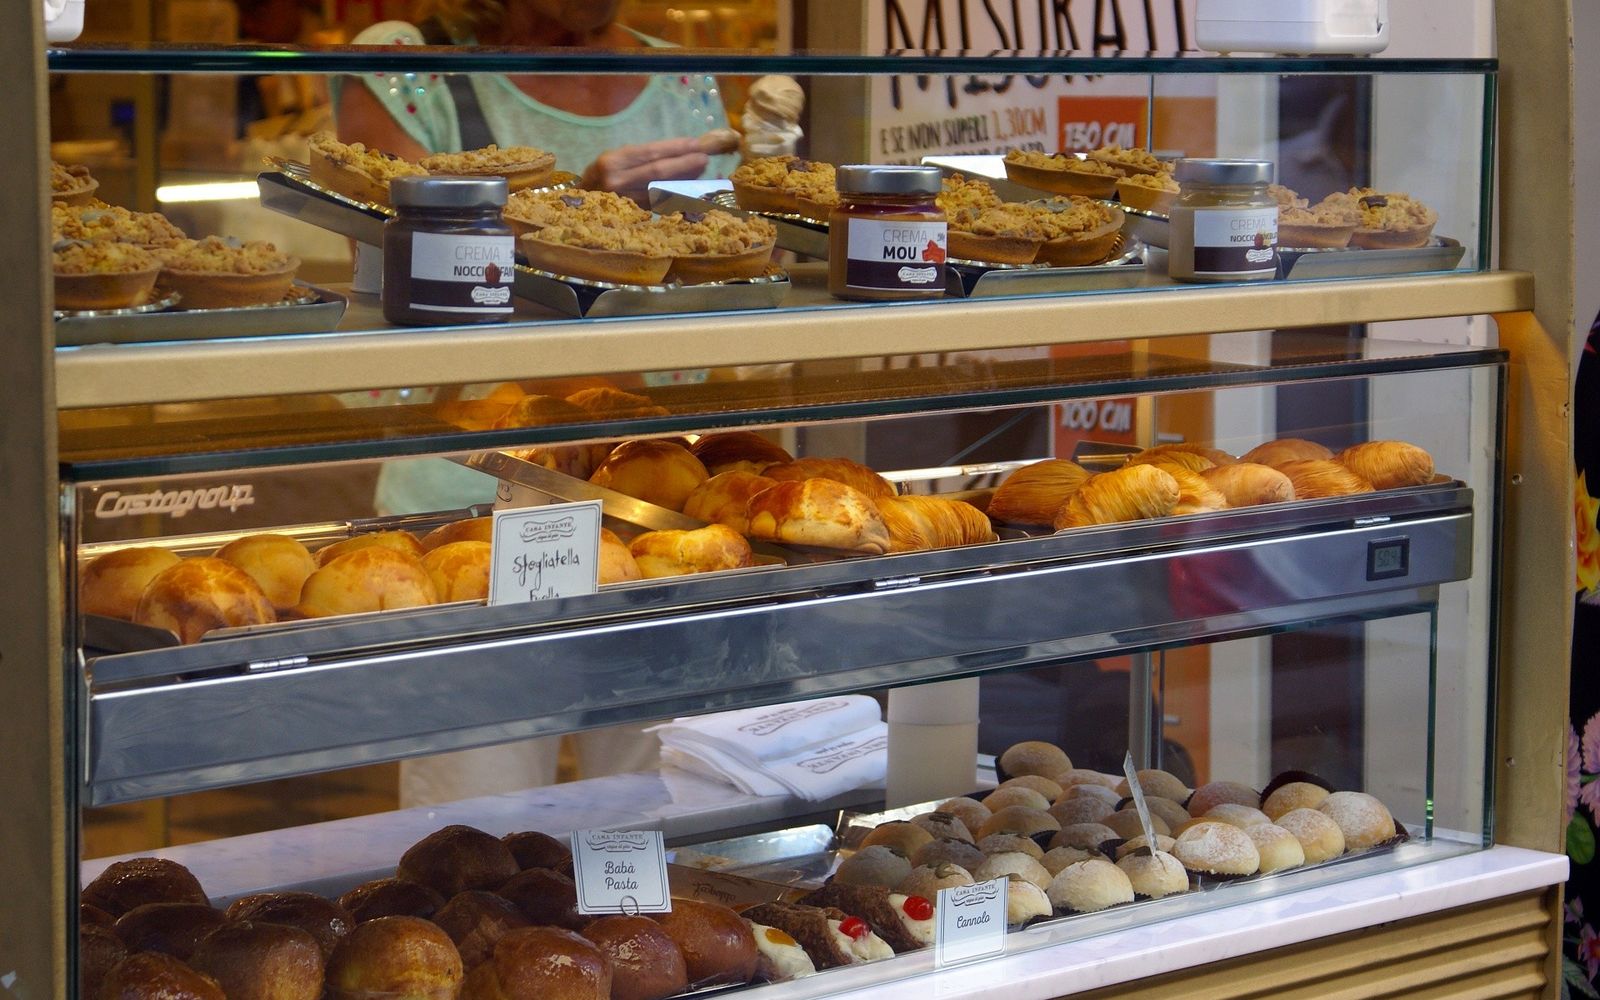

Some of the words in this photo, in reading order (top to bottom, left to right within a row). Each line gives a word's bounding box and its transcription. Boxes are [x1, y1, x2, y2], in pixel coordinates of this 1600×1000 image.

[879, 127, 890, 154] E
[890, 126, 905, 153] SE
[908, 120, 941, 150] NON
[944, 114, 990, 146] SUPERI
[1104, 121, 1136, 150] CM
[1230, 218, 1266, 231] CREMA
[883, 229, 928, 243] CREMA
[455, 245, 500, 261] CREMA
[883, 246, 917, 260] MOU
[1062, 400, 1098, 430] 100
[1101, 401, 1133, 432] CM
[95, 484, 255, 519] Costagroup
[512, 548, 580, 590] Sfogliatella
[604, 860, 636, 875] Babà
[604, 876, 639, 891] Pasta
[957, 911, 991, 929] Cannolo
